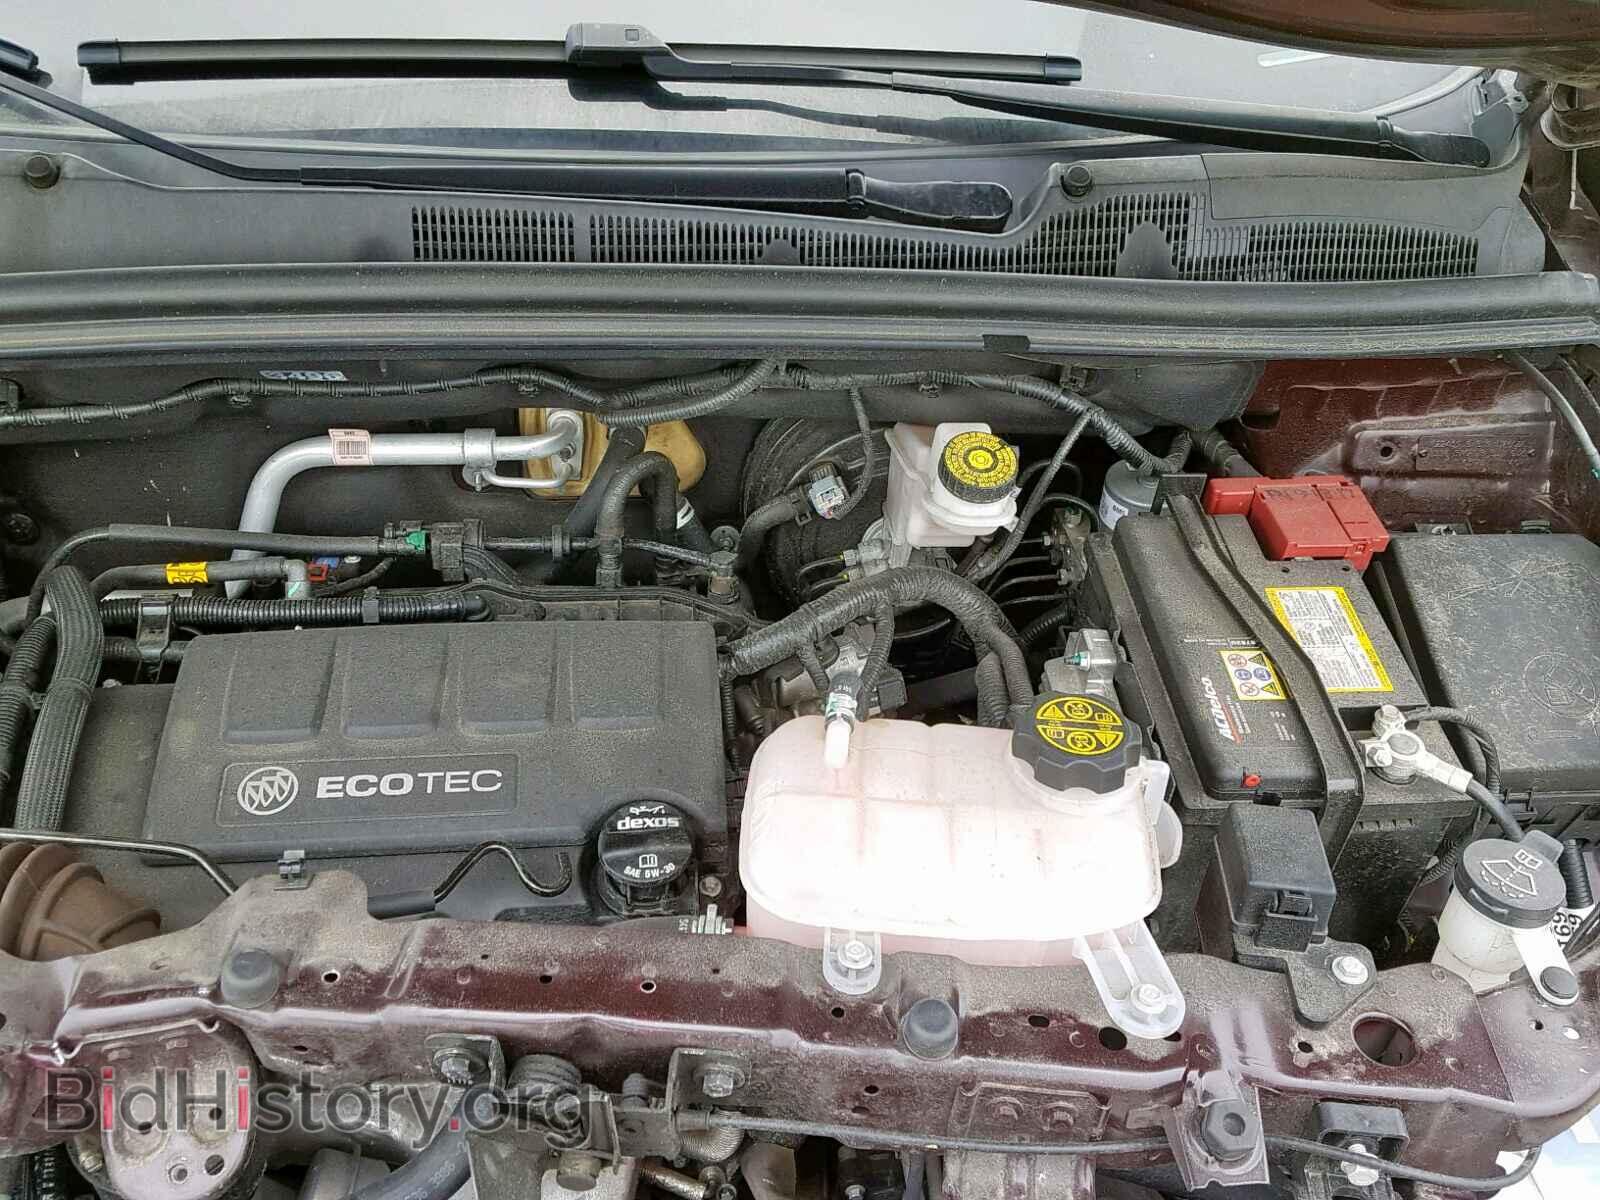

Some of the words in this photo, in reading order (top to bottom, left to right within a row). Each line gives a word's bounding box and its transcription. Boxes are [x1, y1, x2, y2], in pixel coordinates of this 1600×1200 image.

[316, 769, 503, 798] ECOTEC
[617, 816, 681, 830] dexos
[624, 865, 641, 878] SAE
